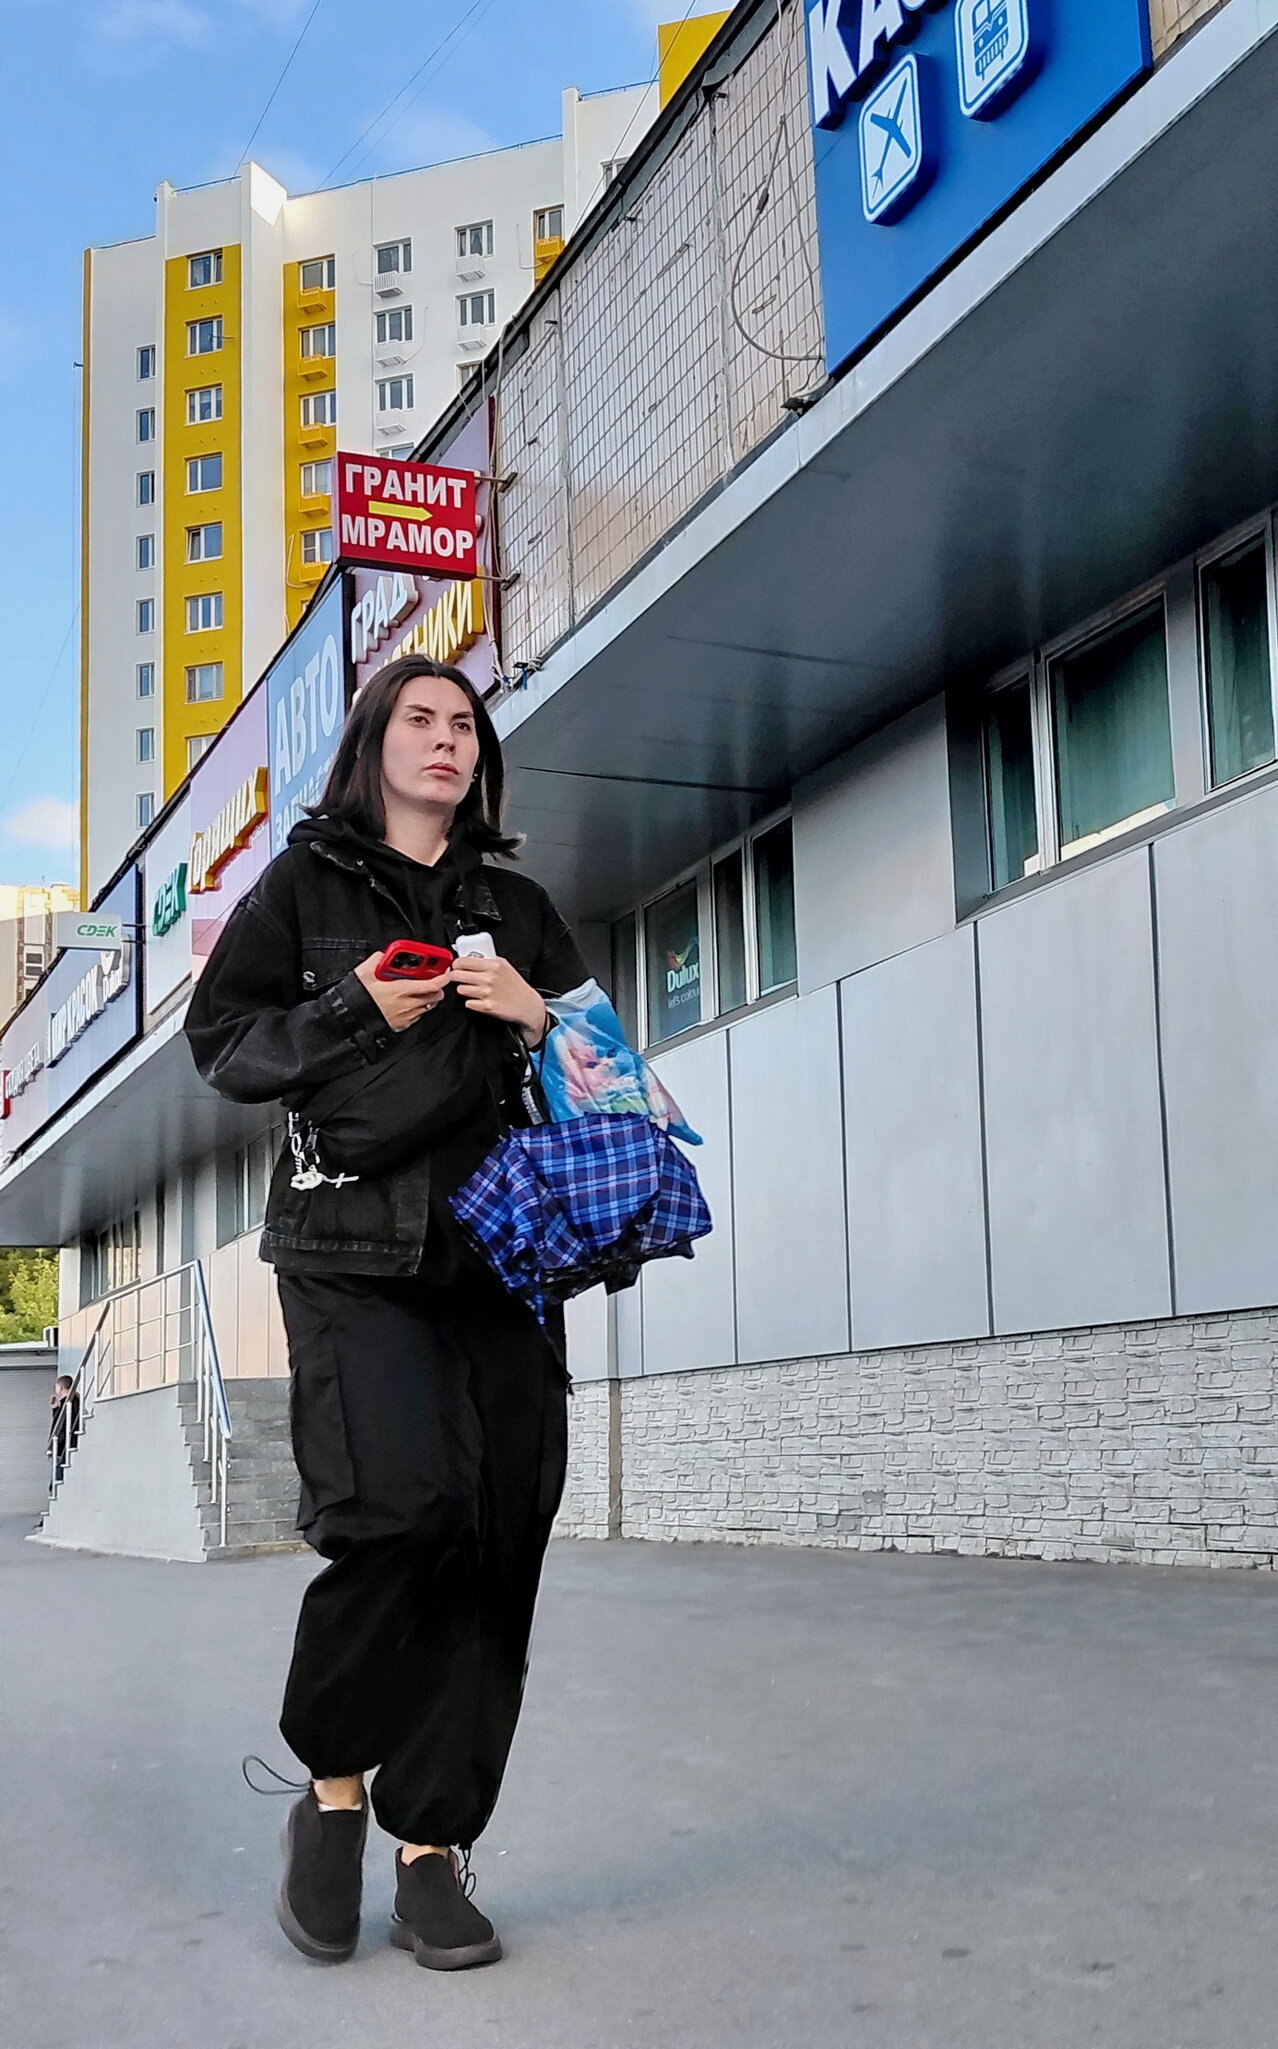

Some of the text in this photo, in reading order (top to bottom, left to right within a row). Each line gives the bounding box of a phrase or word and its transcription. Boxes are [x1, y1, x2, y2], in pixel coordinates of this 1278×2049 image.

[809, 0, 925, 126] КА
[344, 463, 467, 508] ГРАНИТ
[341, 513, 474, 559] МРАМОР
[274, 634, 339, 797] АВТО
[77, 924, 118, 938] CDEK
[667, 962, 699, 993] Dulux
